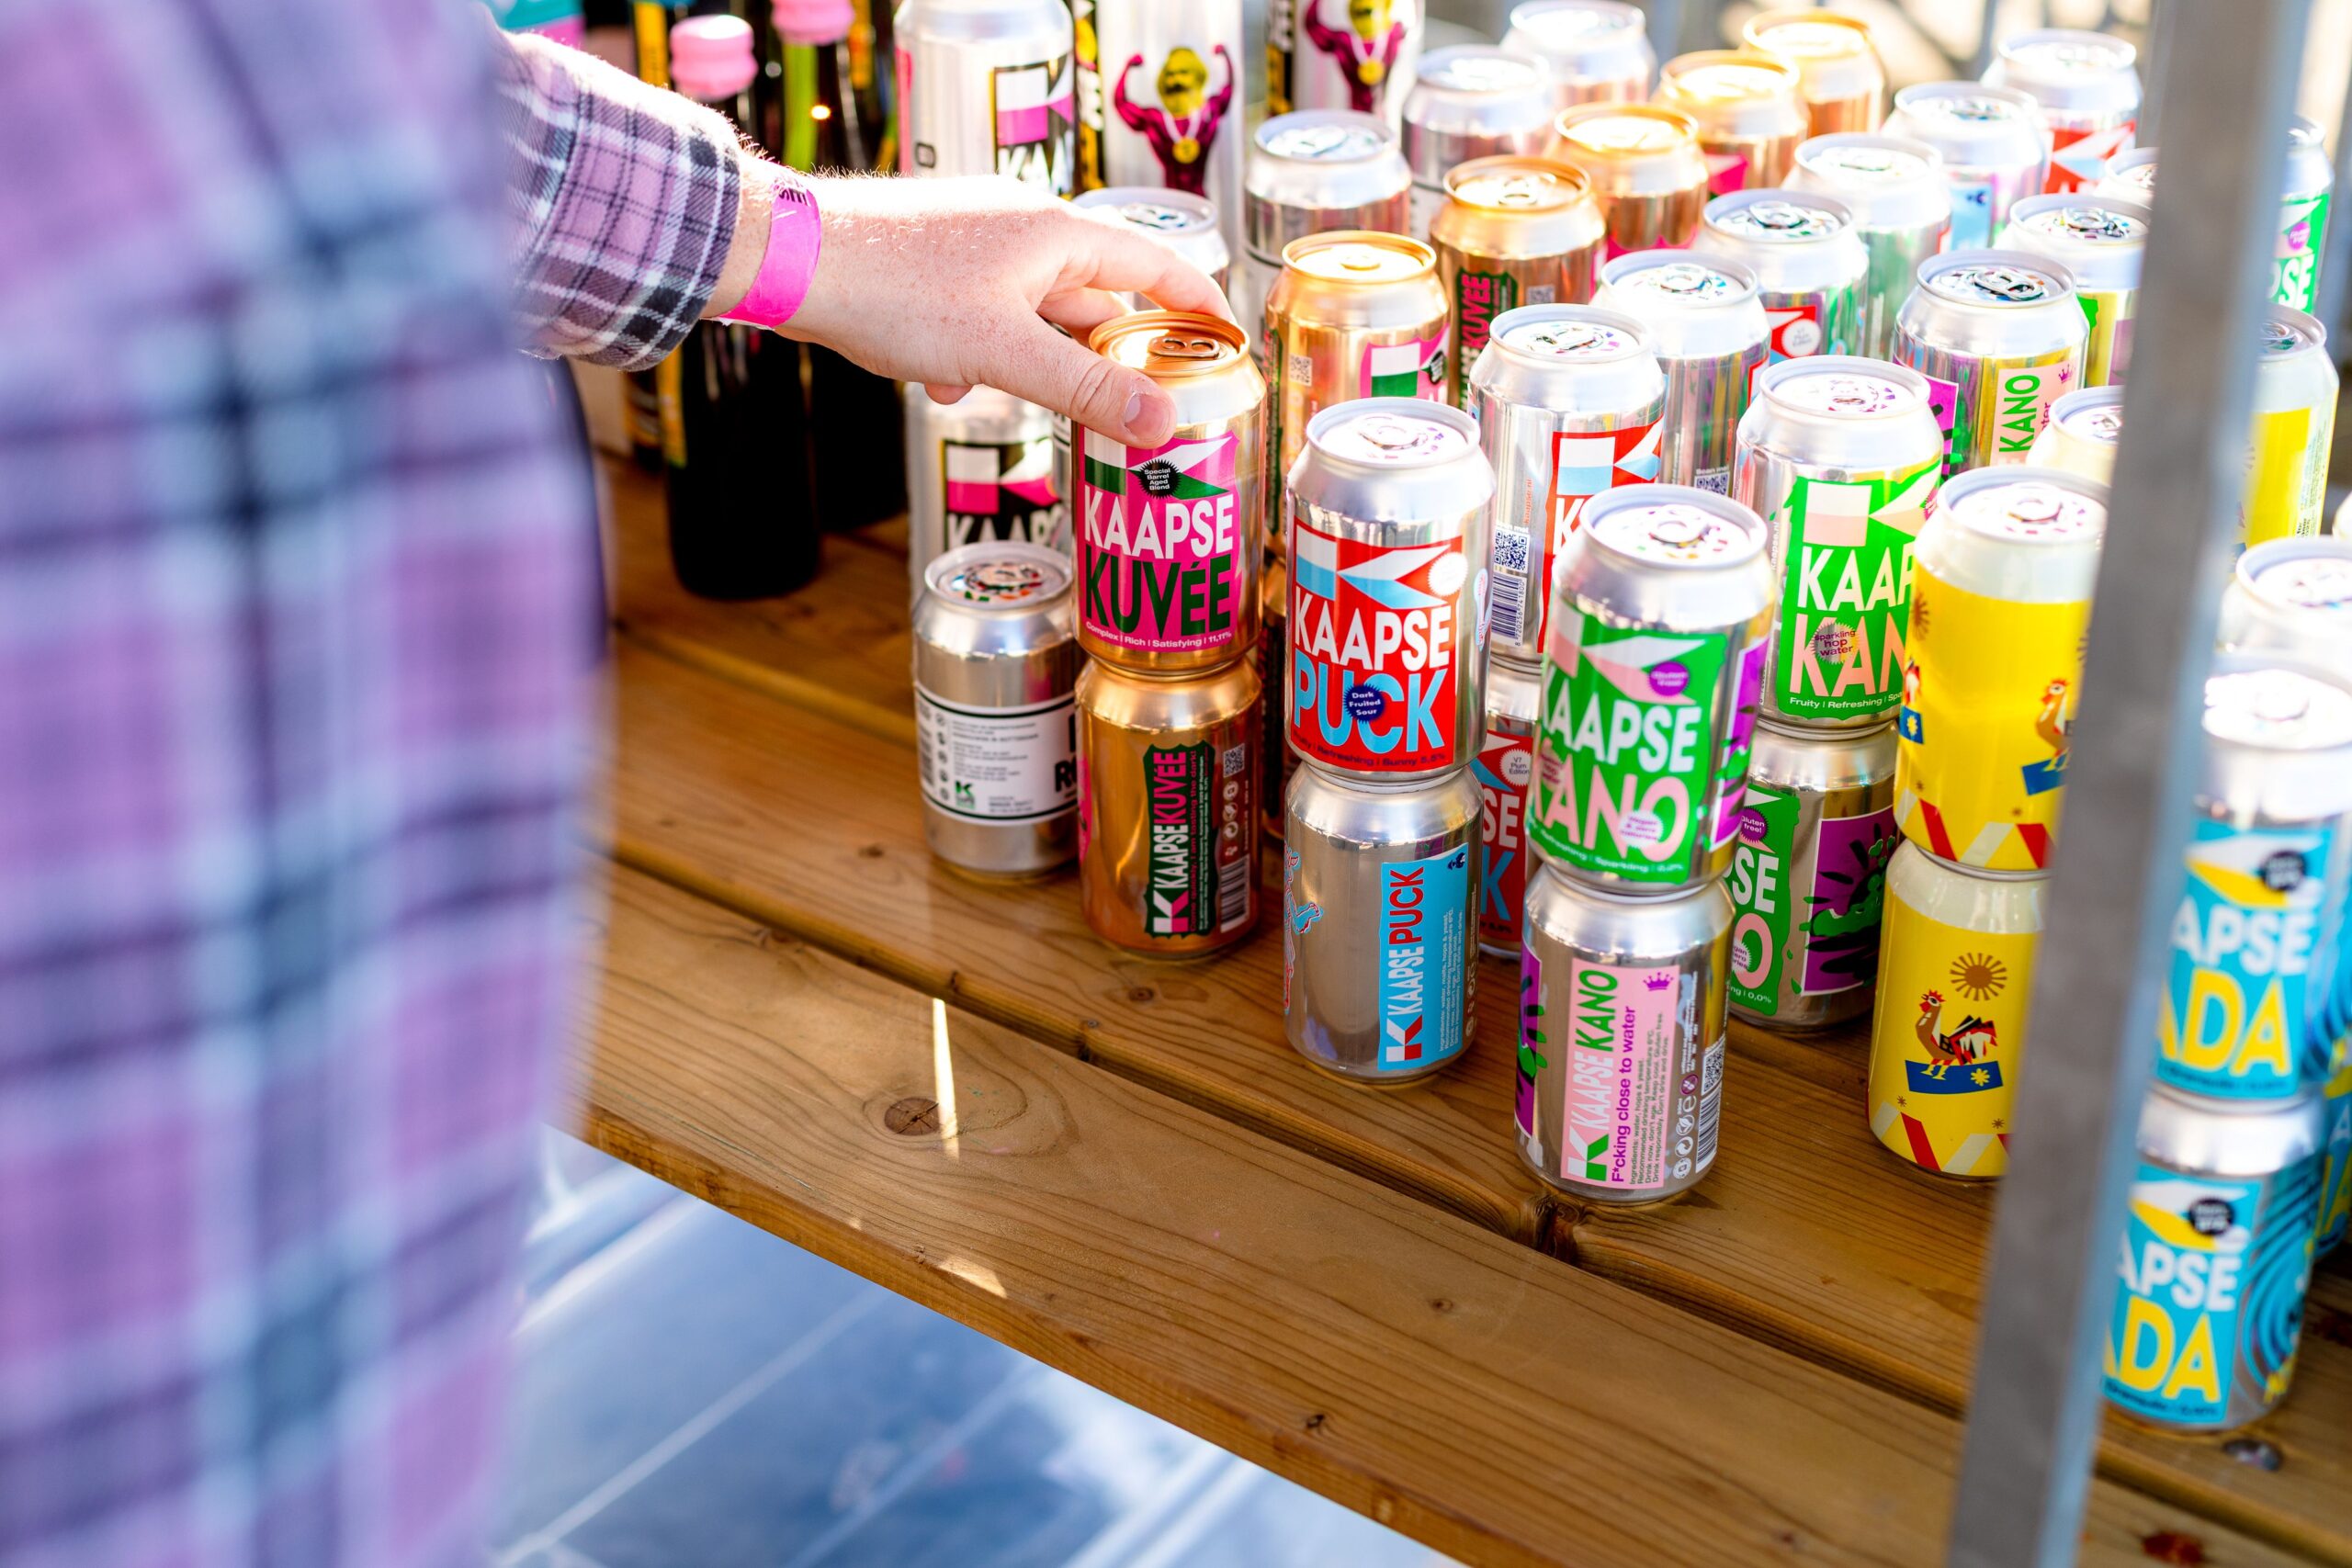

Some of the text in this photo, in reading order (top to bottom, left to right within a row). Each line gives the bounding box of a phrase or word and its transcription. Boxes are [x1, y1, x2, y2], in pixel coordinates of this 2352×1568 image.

[1998, 375, 2041, 452] KANO
[1084, 486, 1233, 558] KAAPSE
[1086, 545, 1232, 638] KUVÉE
[1085, 621, 1136, 641] Complex
[1125, 637, 1146, 646] Rich
[1152, 637, 1202, 649] Satisfying
[1295, 586, 1452, 671] KAAPSE
[1814, 630, 1856, 641] sparkling
[1819, 646, 1853, 656] water
[1824, 637, 1848, 648] hop
[1294, 648, 1448, 754] PUCK
[1349, 699, 1381, 707] Fruited
[1790, 697, 1820, 709] Fruity
[1827, 698, 1883, 709] Refreshing
[1153, 751, 1188, 825] KUVÉE
[1153, 825, 1189, 889] KAAPSE
[1388, 867, 1424, 945] PUCK
[1387, 946, 1424, 1016] KAAPSE
[1575, 969, 1619, 1052] KANO
[1747, 990, 1772, 1003] 0,0%
[1621, 1006, 1638, 1053] water
[2155, 966, 2292, 1077] DA
[1571, 1051, 1613, 1131] KAAPSE
[1620, 1057, 1634, 1073] to
[1616, 1077, 1633, 1121] close
[1642, 1095, 1650, 1125] drinking
[1630, 1138, 1639, 1184] Ingredients:
[1638, 1128, 1648, 1184] Recommended
[2103, 1295, 2222, 1403] DA
